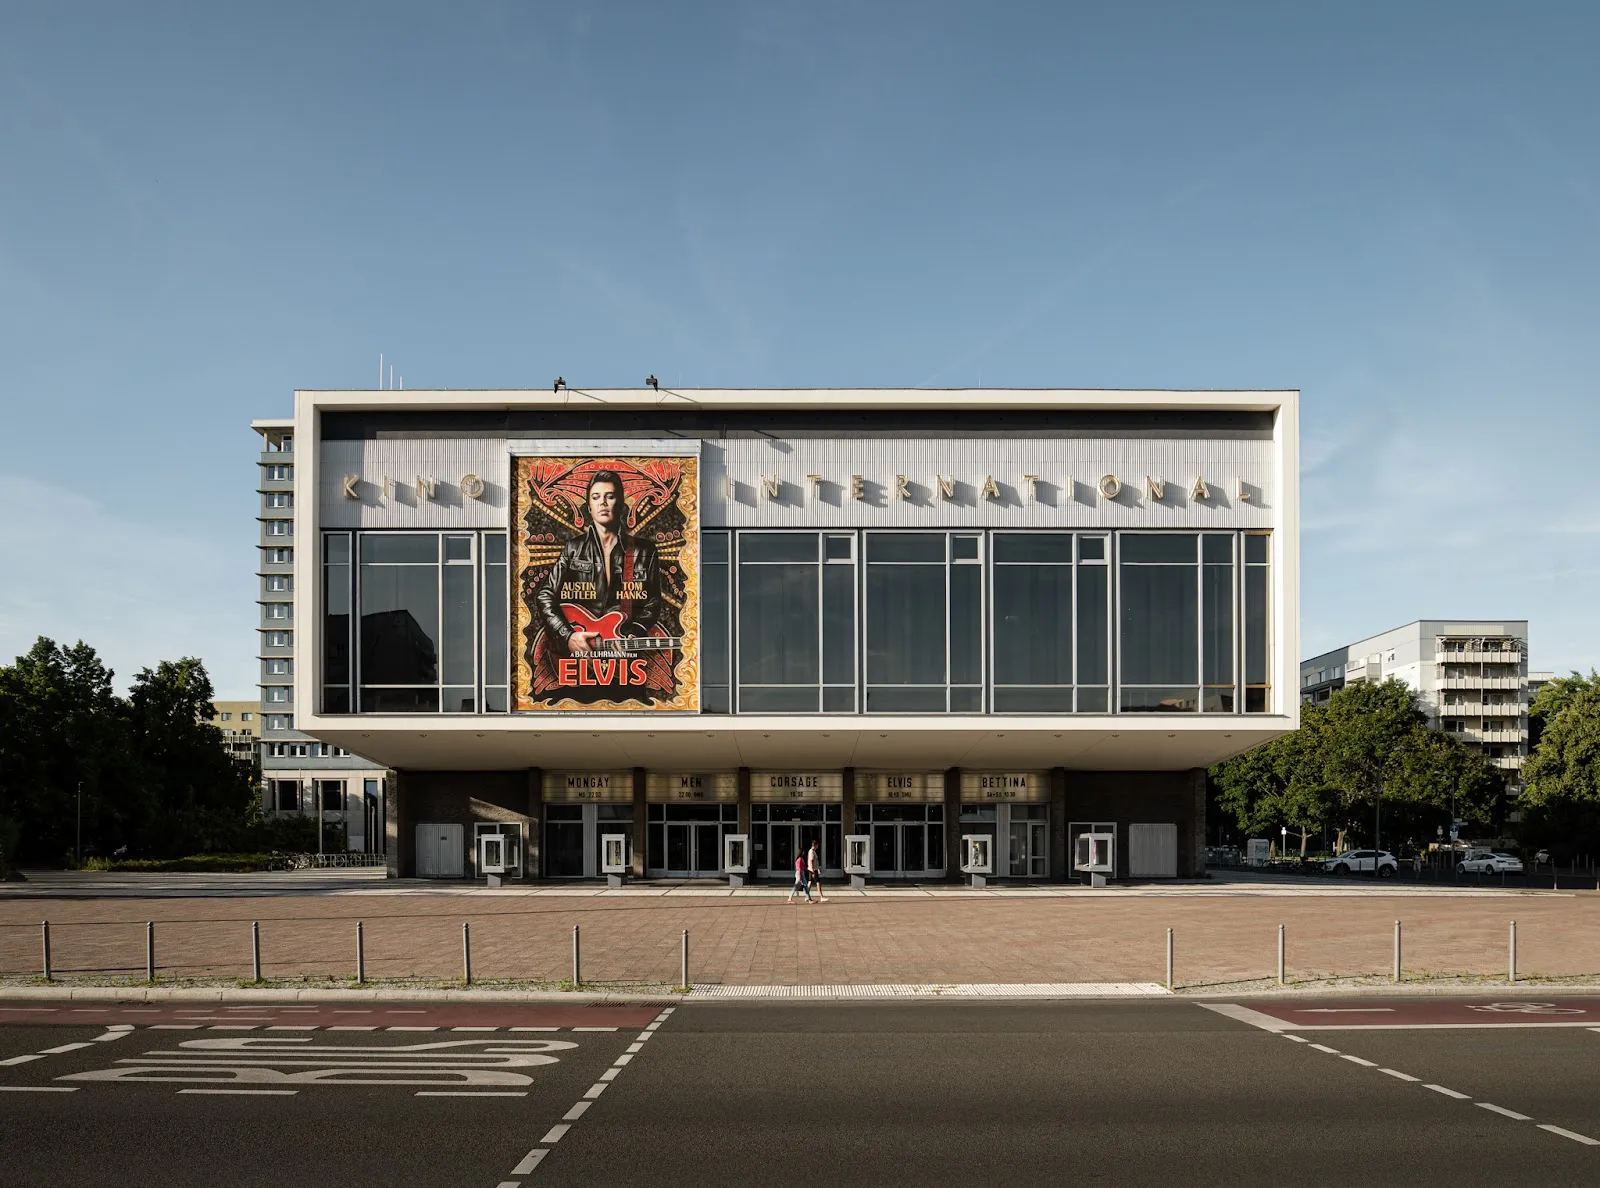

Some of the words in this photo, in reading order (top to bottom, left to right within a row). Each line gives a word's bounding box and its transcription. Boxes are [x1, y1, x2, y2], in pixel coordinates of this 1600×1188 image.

[344, 474, 484, 498] KINO
[725, 474, 1252, 499] INTERNATIONAL
[562, 581, 596, 591] AUSTIN
[622, 581, 643, 591] TOM
[560, 590, 597, 600] BUTLER
[616, 590, 648, 600] HANKS
[558, 658, 648, 686] ELVIS
[568, 777, 609, 787] MONGAY
[681, 777, 702, 787] MEN
[770, 776, 818, 787] CORSAGE
[887, 777, 912, 788] ELVIS
[982, 777, 1026, 788] BETTINA
[53, 1037, 580, 1086] BUS
